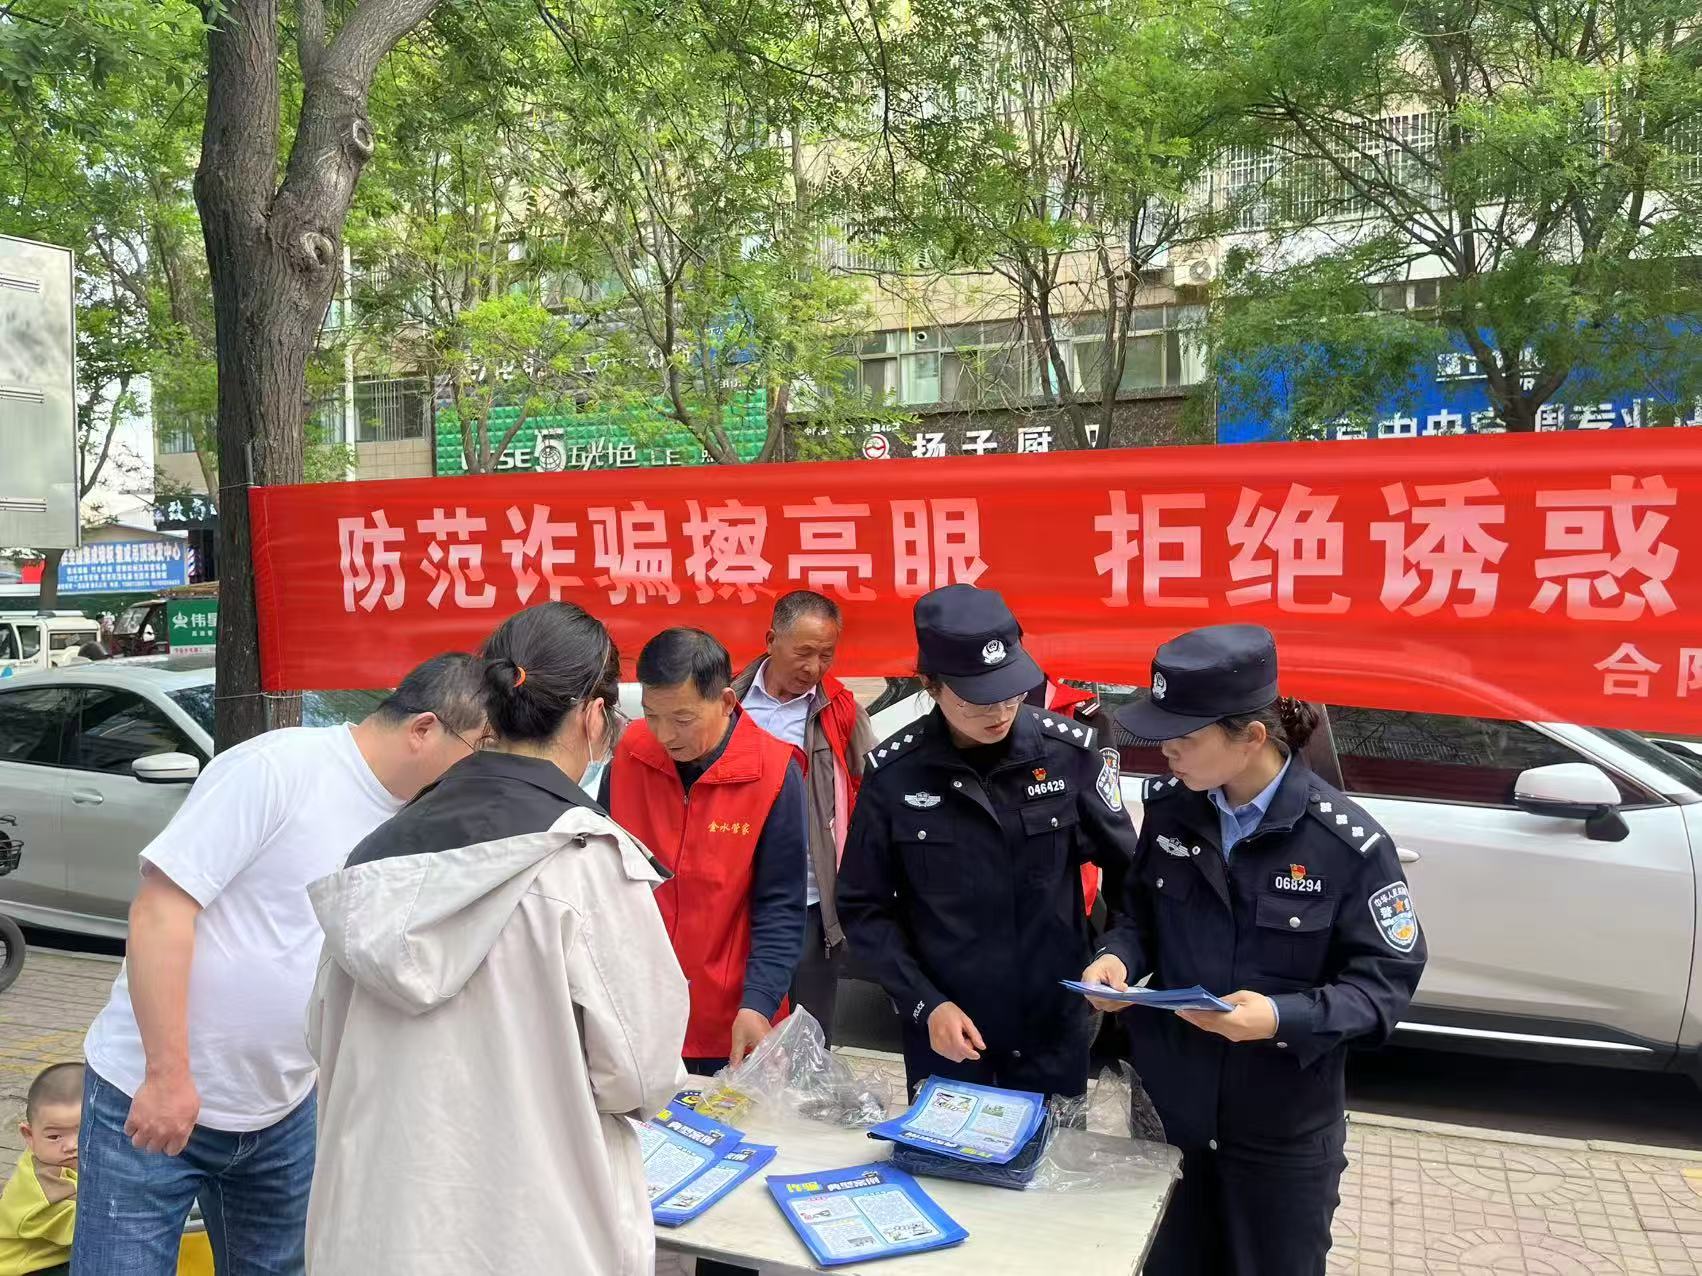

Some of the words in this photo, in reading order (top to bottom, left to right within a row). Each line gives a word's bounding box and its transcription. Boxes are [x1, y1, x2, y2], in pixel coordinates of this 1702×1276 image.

[337, 496, 989, 613] 防范诈骗擦亮眼
[1094, 475, 1680, 622] 拒绝诱惑
[1027, 779, 1066, 798] 046429
[1275, 876, 1322, 893] 068294
